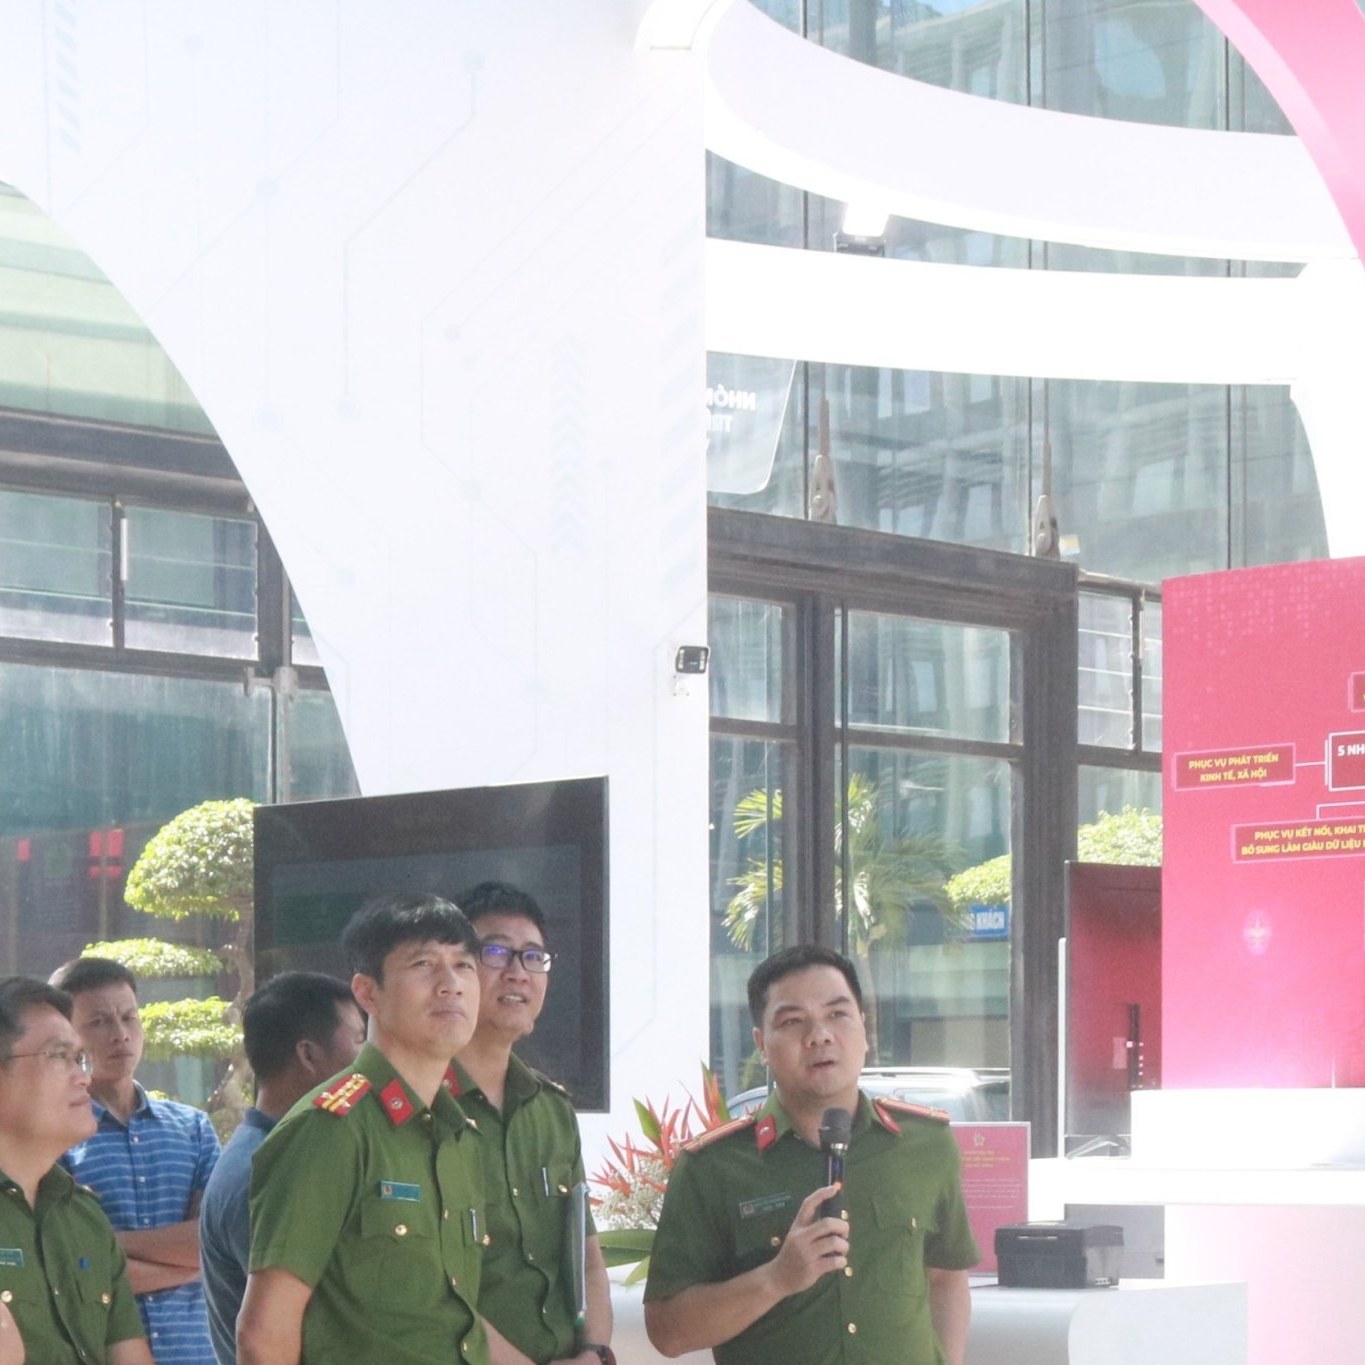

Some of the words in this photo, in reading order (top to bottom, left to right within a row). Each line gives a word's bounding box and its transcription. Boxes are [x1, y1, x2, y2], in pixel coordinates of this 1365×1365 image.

[1337, 745, 1345, 756] 5
[1254, 830, 1280, 841] PHỤC
[1281, 829, 1294, 840] VỤ
